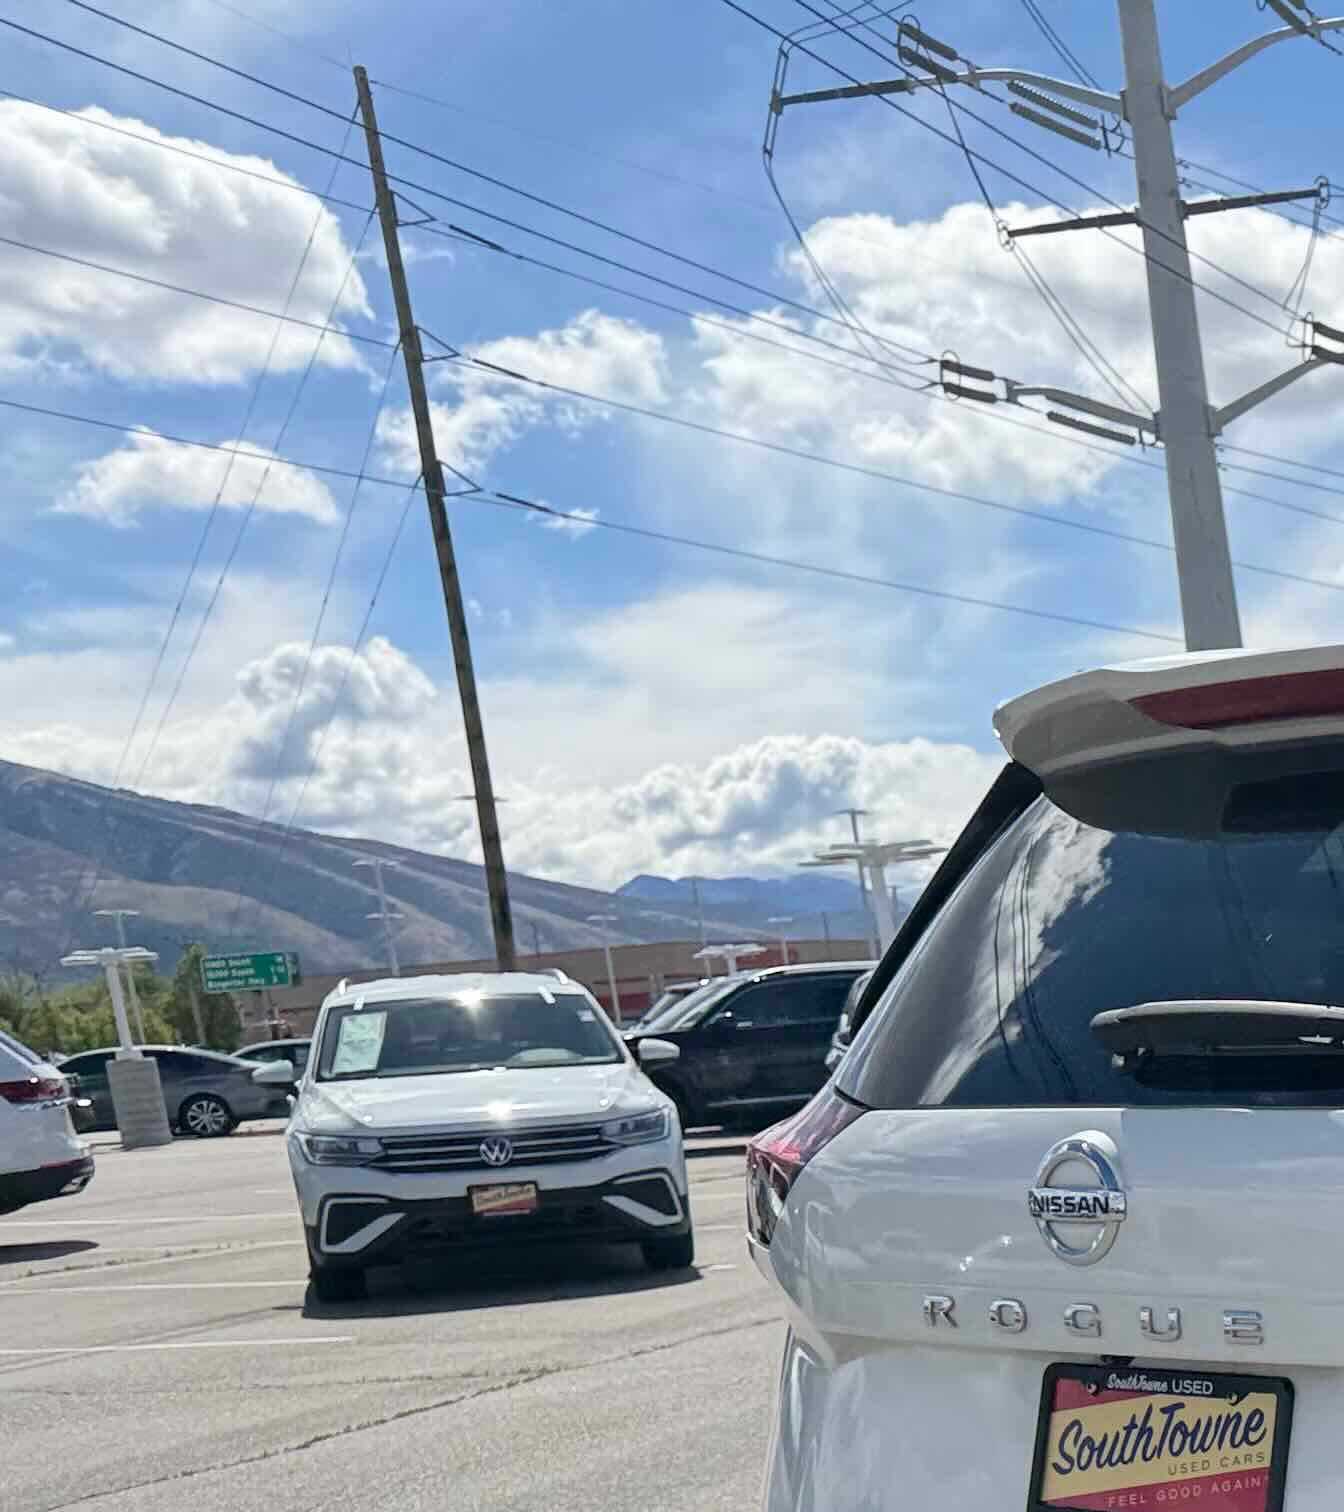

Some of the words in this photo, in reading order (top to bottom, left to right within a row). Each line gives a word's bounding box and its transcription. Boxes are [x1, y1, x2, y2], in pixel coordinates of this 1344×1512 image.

[1033, 1194, 1110, 1215] NISSAN
[923, 1294, 1265, 1346] ROGUE
[1107, 1373, 1168, 1393] SouthTowne
[1172, 1378, 1214, 1395] USED
[1052, 1402, 1268, 1476] SouthTowne
[1167, 1460, 1212, 1477] USED
[1219, 1451, 1267, 1469] CARS
[1106, 1491, 1148, 1508] FEEL
[1156, 1485, 1203, 1502] GOOD
